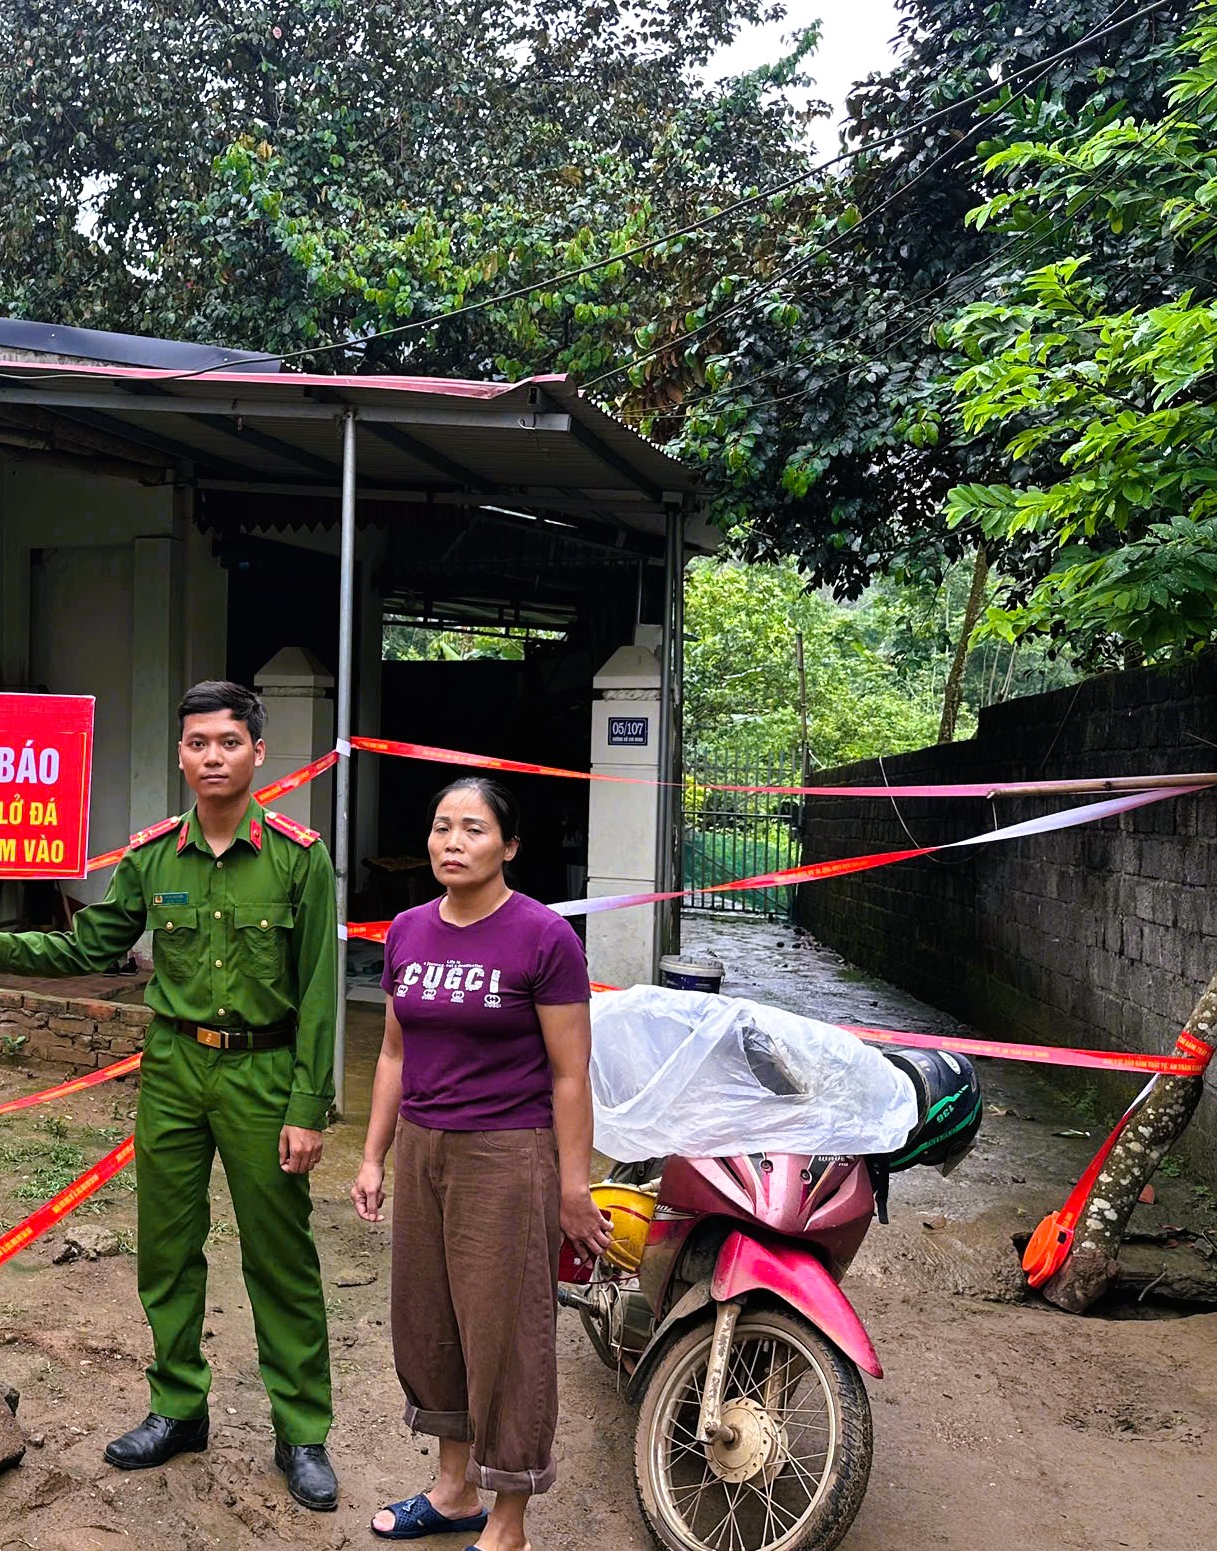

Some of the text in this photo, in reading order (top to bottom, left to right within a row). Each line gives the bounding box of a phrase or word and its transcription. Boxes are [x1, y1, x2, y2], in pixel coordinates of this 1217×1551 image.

[613, 721, 643, 735] 05/107
[30, 798, 58, 825] ĐÁ
[24, 833, 64, 863] VÀO
[403, 962, 501, 993] CUGCI
